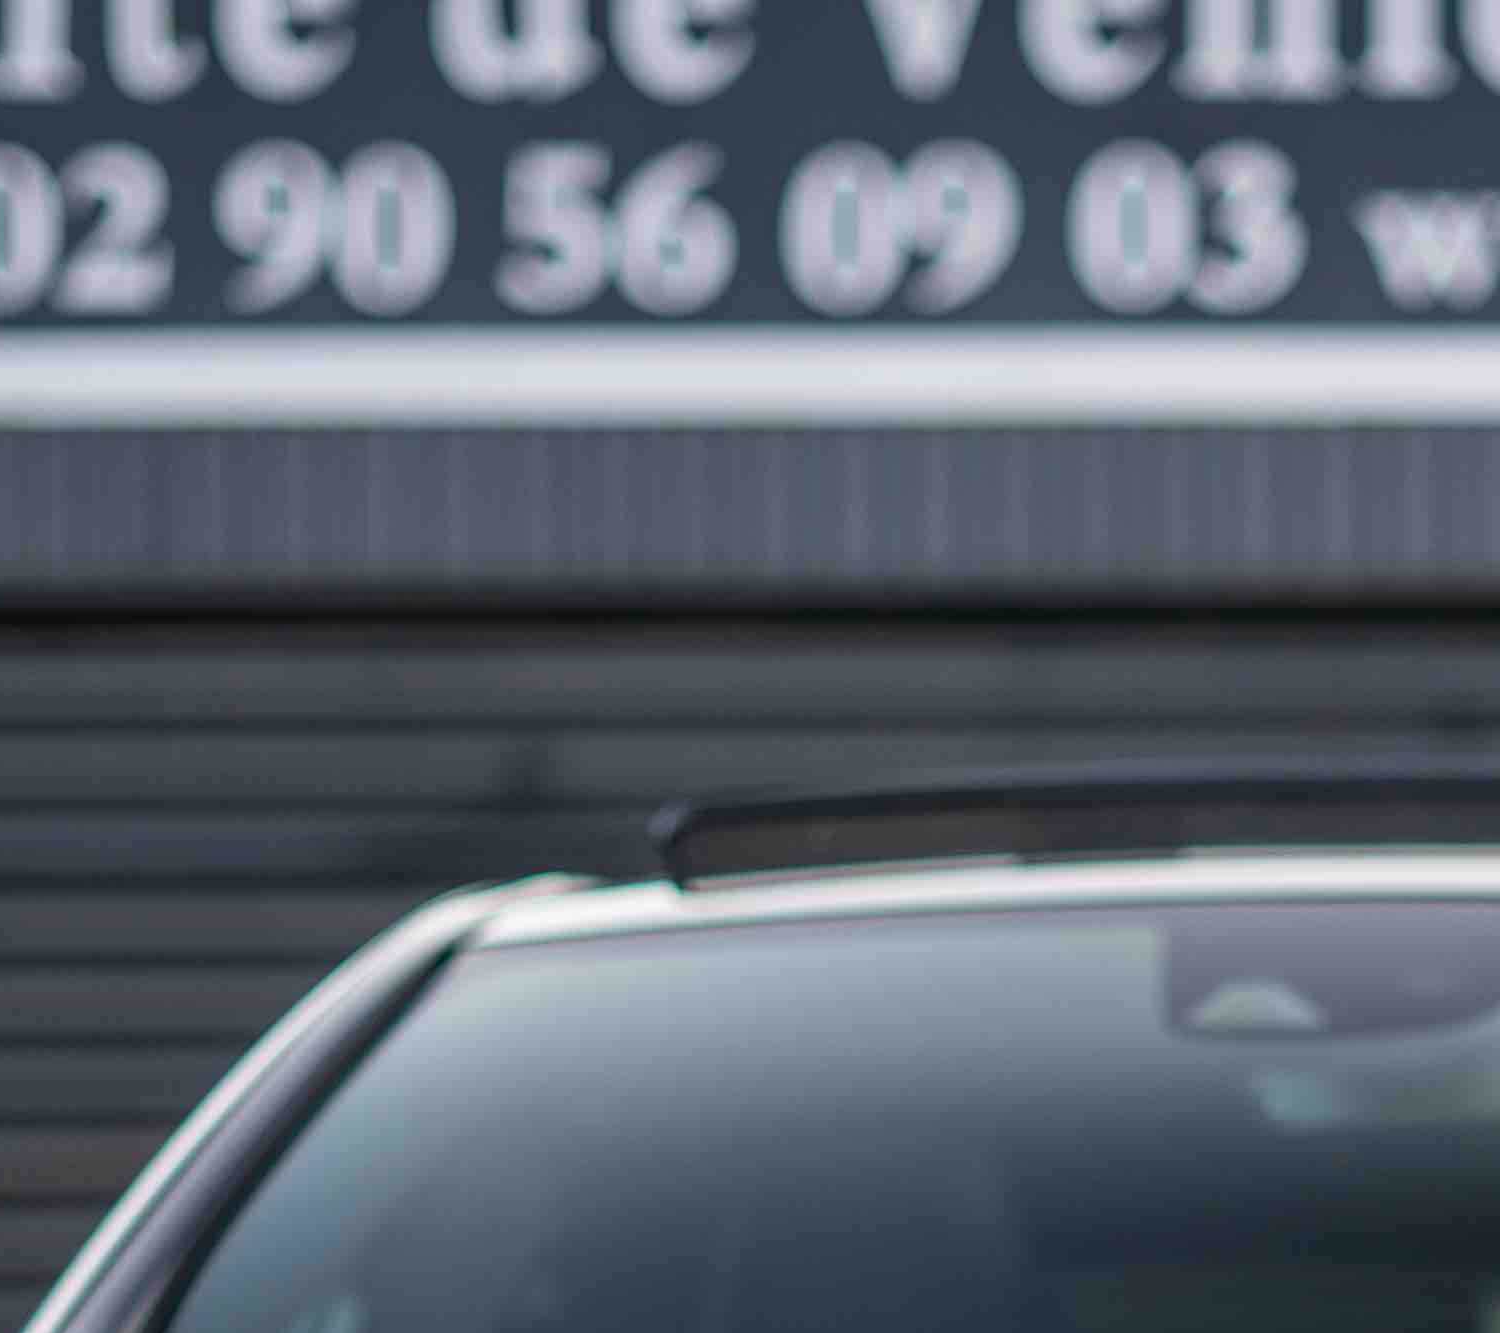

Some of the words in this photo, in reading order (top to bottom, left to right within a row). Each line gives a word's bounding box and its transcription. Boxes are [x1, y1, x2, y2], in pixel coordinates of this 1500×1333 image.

[211, 139, 457, 316] 90
[493, 140, 740, 316] 56
[778, 139, 1025, 317] 09
[1065, 139, 1310, 316] 03
